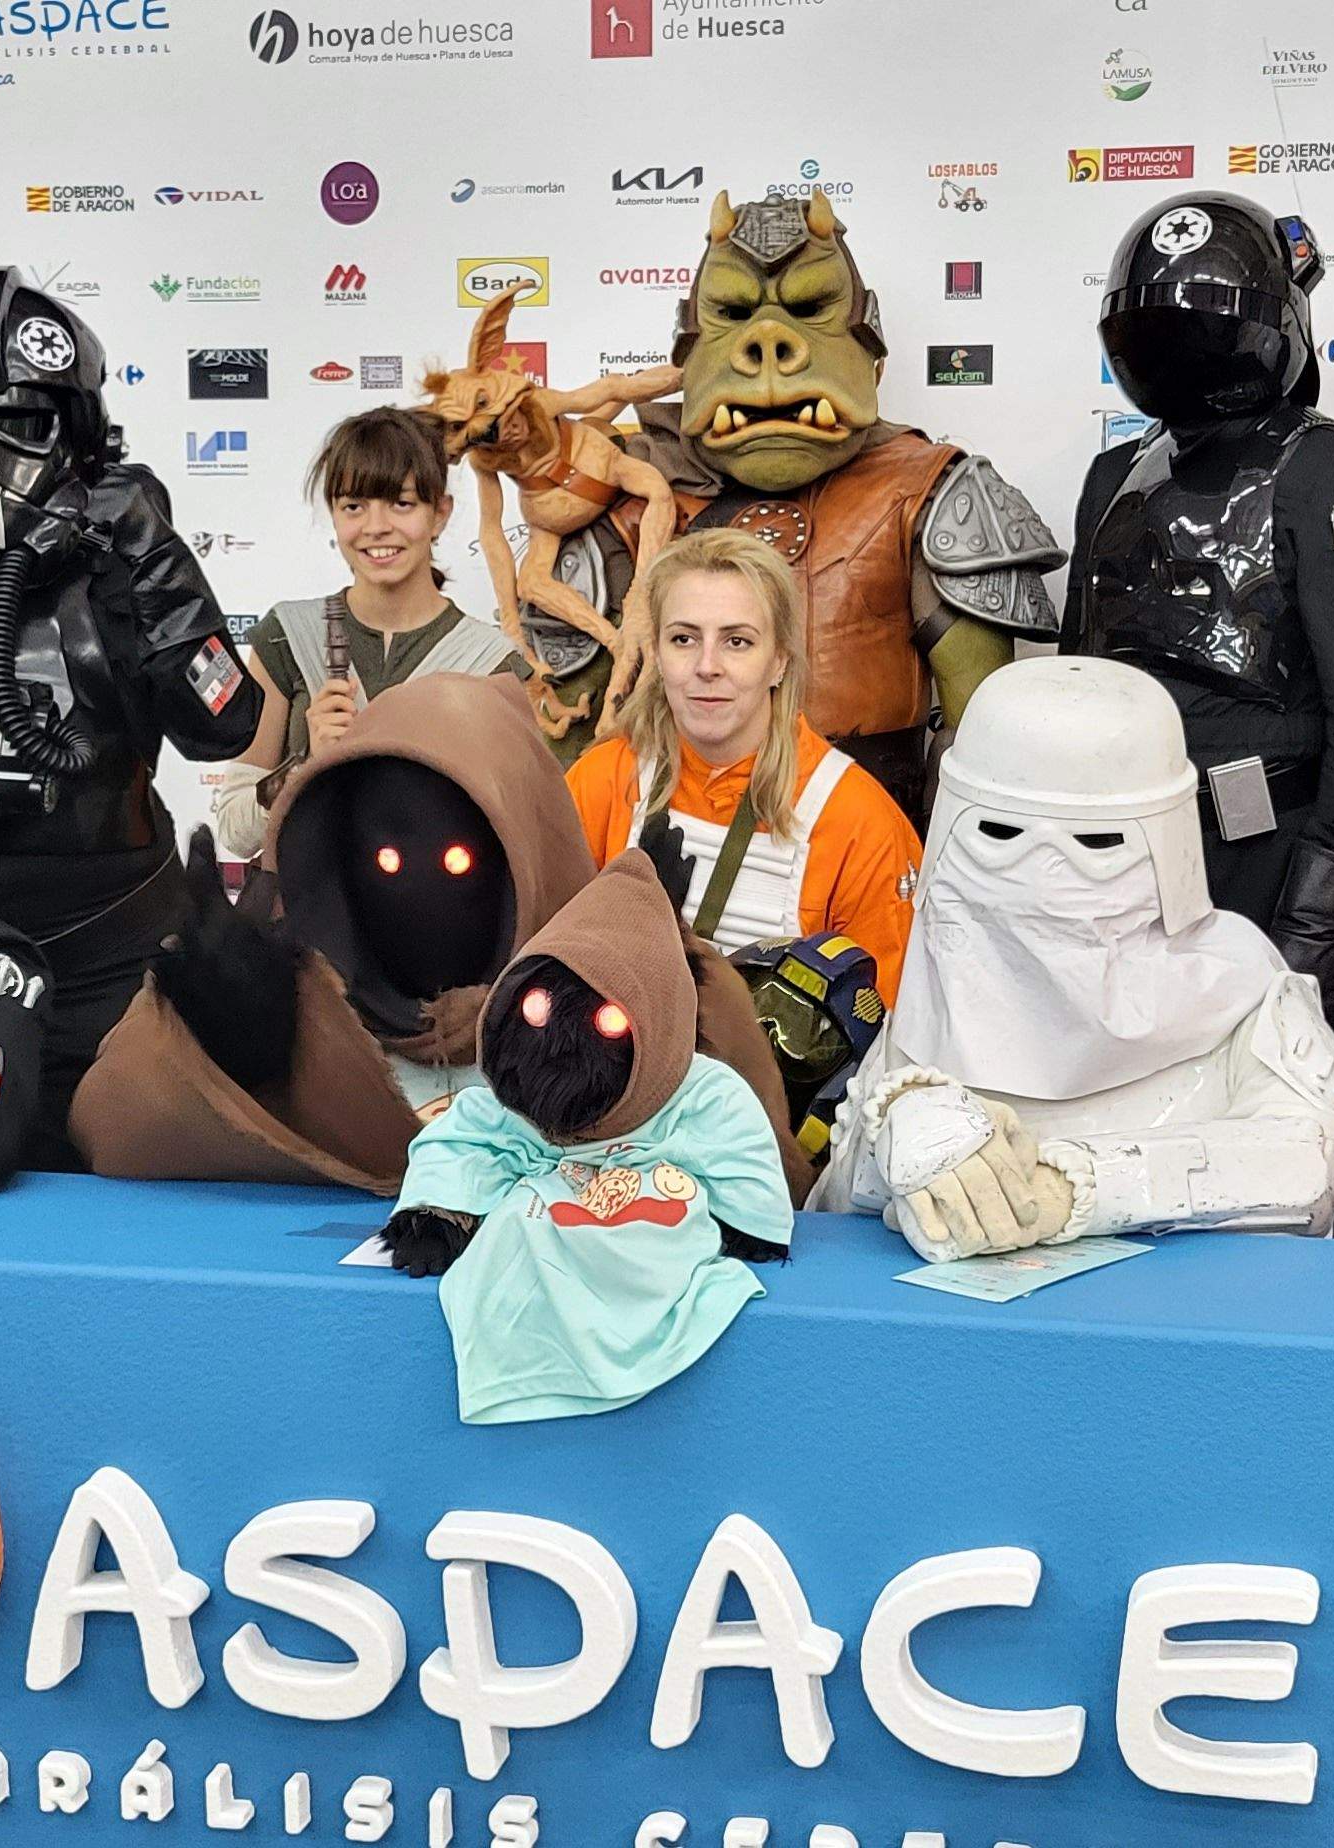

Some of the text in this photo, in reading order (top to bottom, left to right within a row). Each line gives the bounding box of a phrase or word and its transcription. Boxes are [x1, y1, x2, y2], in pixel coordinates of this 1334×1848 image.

[662, 16, 785, 39] de Huesca
[308, 18, 513, 52] hoya de huesca
[71, 44, 171, 56] CEREBRAL
[308, 54, 351, 64] Comarca
[353, 54, 378, 64] Hoya
[380, 53, 393, 62] de
[395, 52, 430, 61] Huesca
[439, 51, 466, 60] Plana
[468, 50, 481, 58] de
[1272, 49, 1316, 62] VIÑAS
[1102, 67, 1152, 80] LAMUSA
[1108, 150, 1182, 165] DIPUTACIÓN
[928, 162, 998, 178] LOSFABLOS
[1108, 164, 1179, 179] DE HUESCA
[1258, 160, 1280, 174] DE
[53, 185, 124, 198] GOBIERNO
[187, 190, 264, 202] VIDAL
[53, 199, 135, 212] DE ARAGON
[616, 195, 700, 206] Automotor Huesca
[186, 275, 260, 290] Fundación
[599, 267, 690, 285] avanza
[56, 282, 101, 292] EACRA
[324, 293, 368, 302] MAZANA
[599, 350, 668, 365] Fundación
[316, 368, 351, 379] Ferrer
[23, 1465, 1323, 1804] ASPACE
